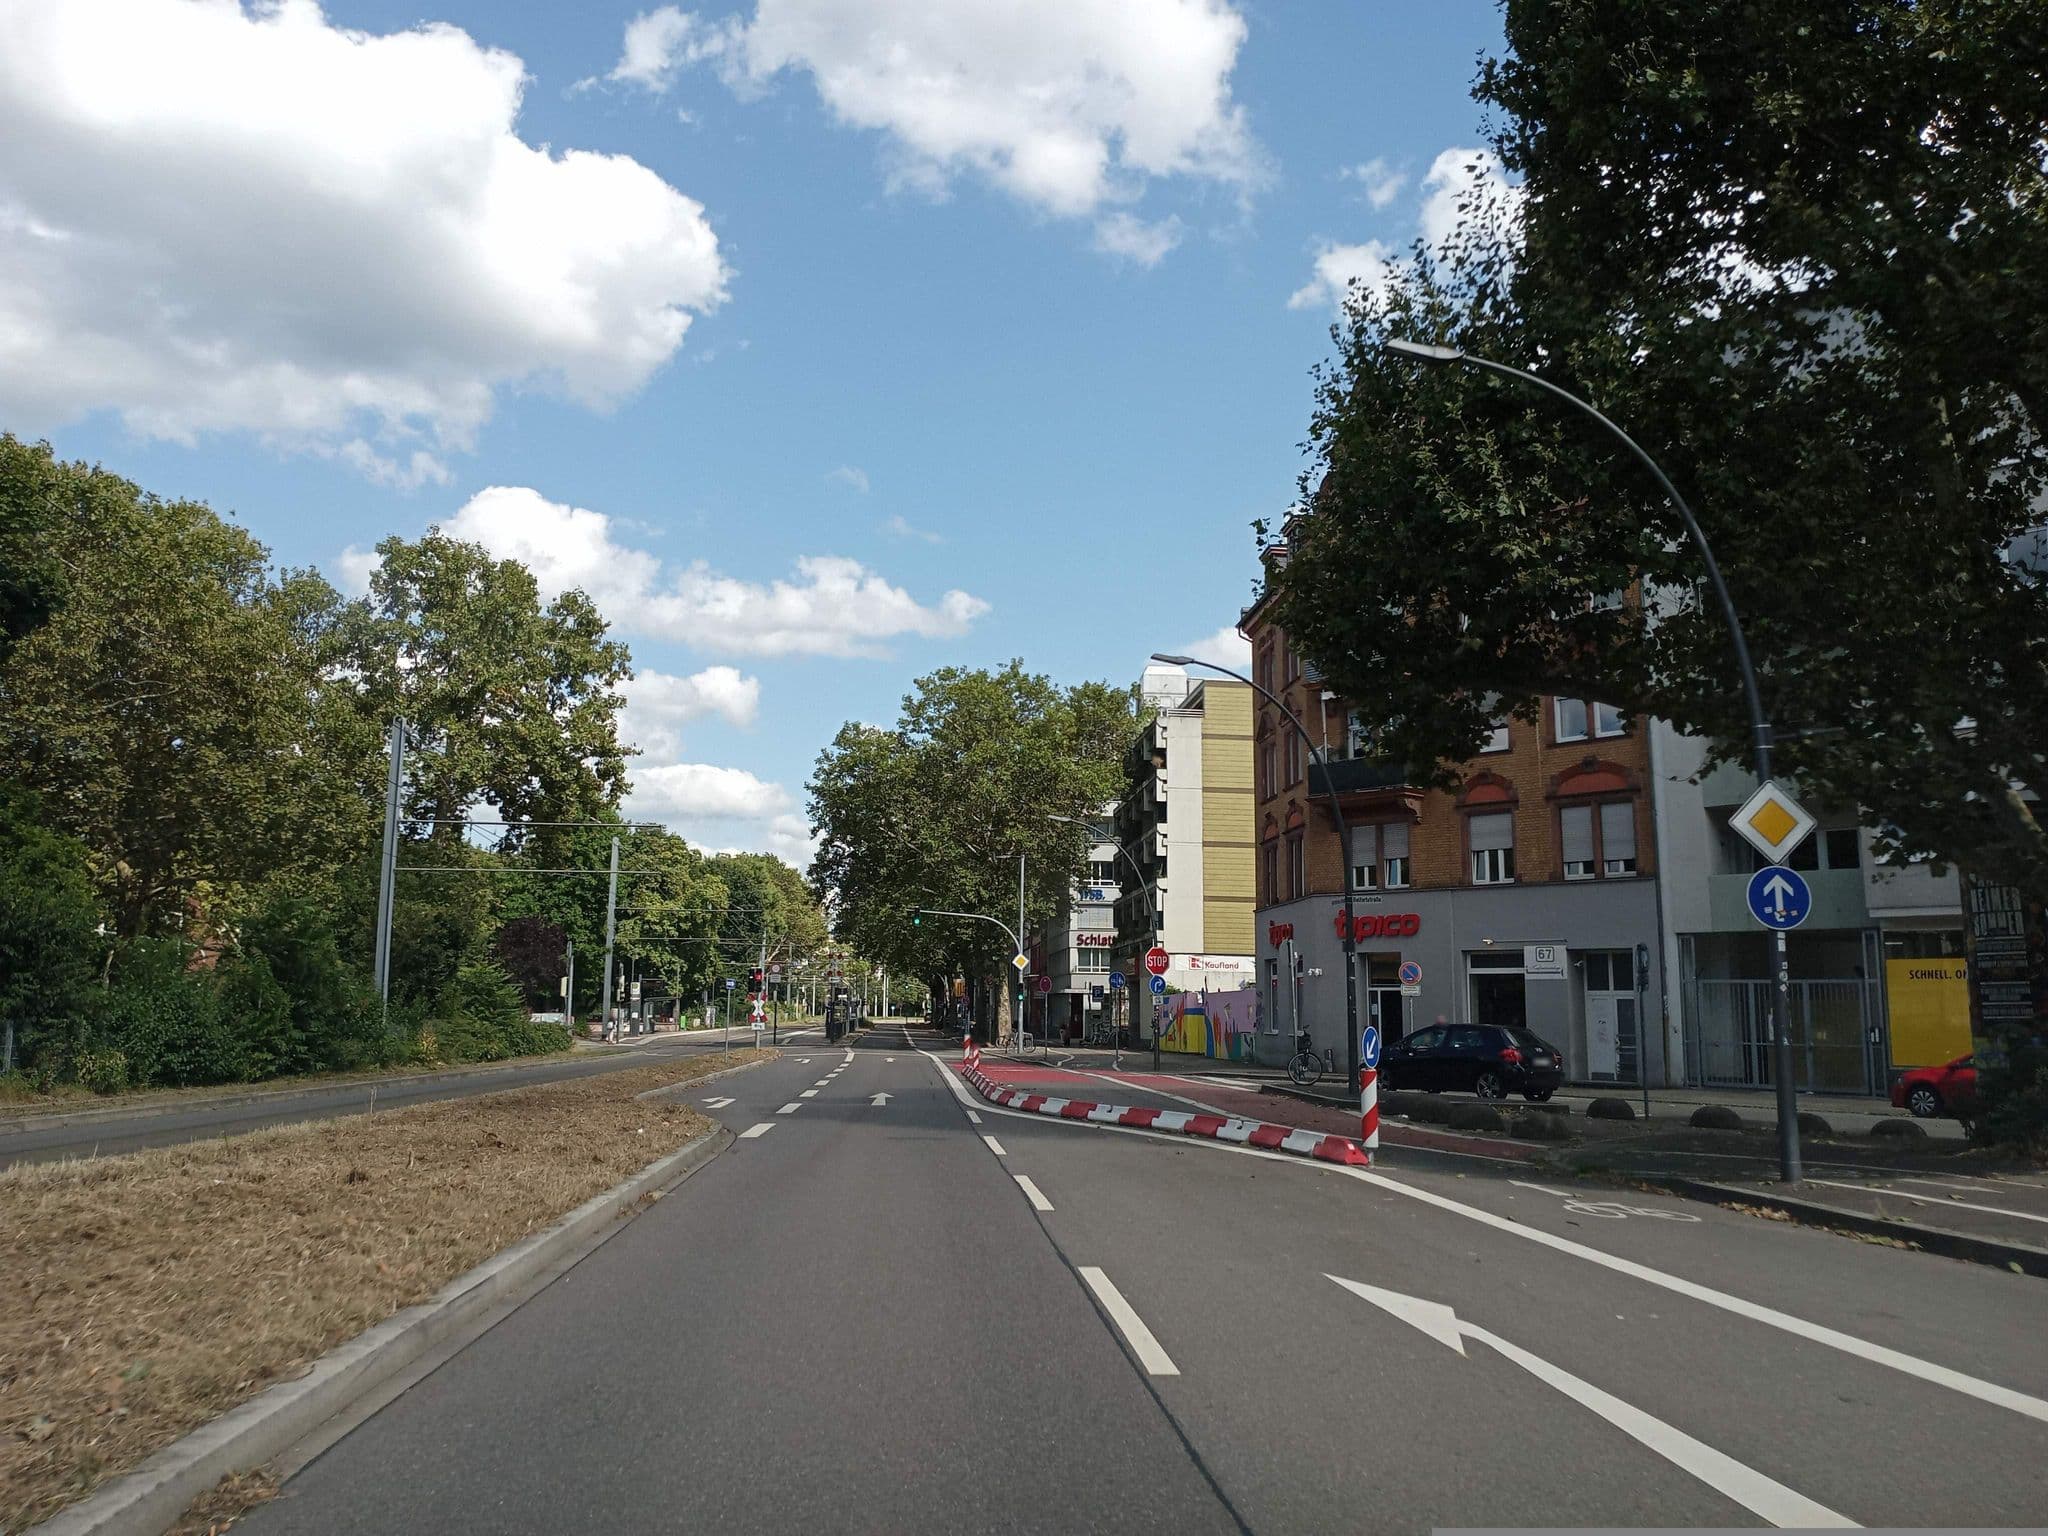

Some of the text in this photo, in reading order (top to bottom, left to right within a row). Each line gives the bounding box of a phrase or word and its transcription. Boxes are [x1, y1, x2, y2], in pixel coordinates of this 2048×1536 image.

[1538, 949, 1552, 959] 67
[1147, 955, 1168, 967] STOP
[1205, 961, 1240, 970] Kaufland
